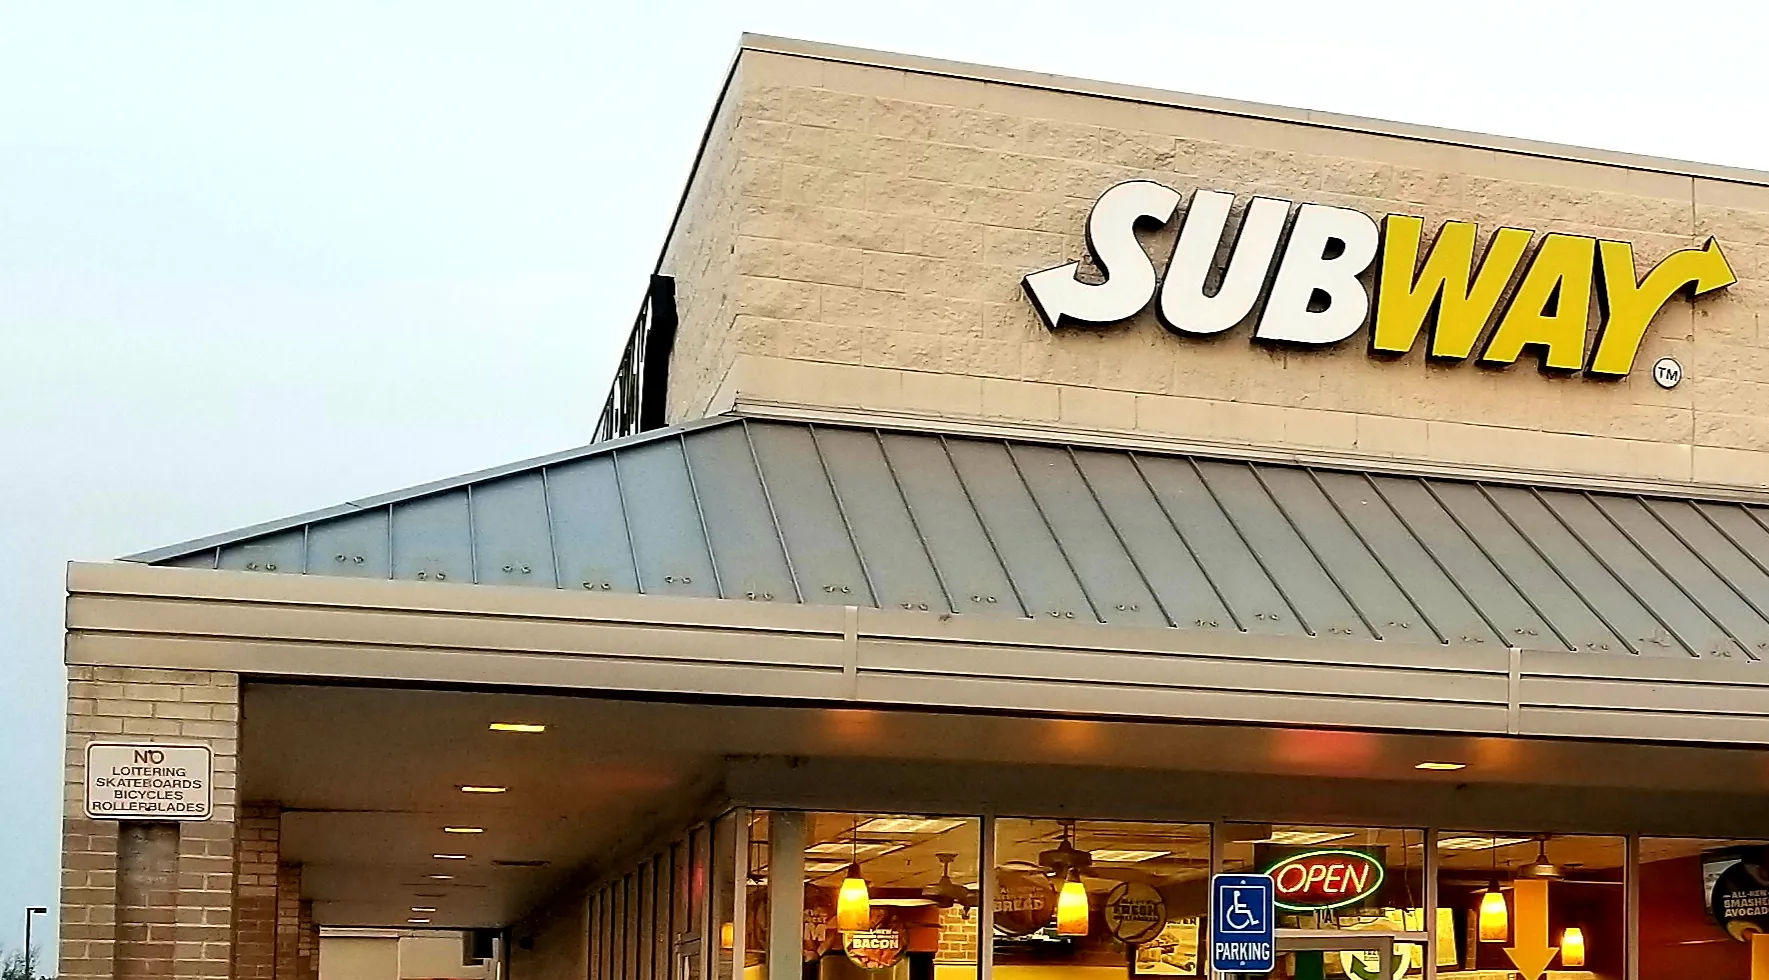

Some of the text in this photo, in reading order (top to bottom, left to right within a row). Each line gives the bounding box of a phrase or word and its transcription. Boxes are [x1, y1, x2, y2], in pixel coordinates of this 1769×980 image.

[1020, 178, 1738, 380] SUBWAY
[1658, 366, 1678, 381] TM
[133, 749, 165, 765] NO
[112, 766, 186, 777] LOITERING
[96, 777, 202, 789] SKATEBOARDS
[114, 790, 184, 801] BICYCLES
[92, 801, 205, 812] ROLLERBLADES
[1276, 863, 1369, 894] OPEN
[853, 938, 899, 949] BACON
[1215, 942, 1270, 961] PARKING
